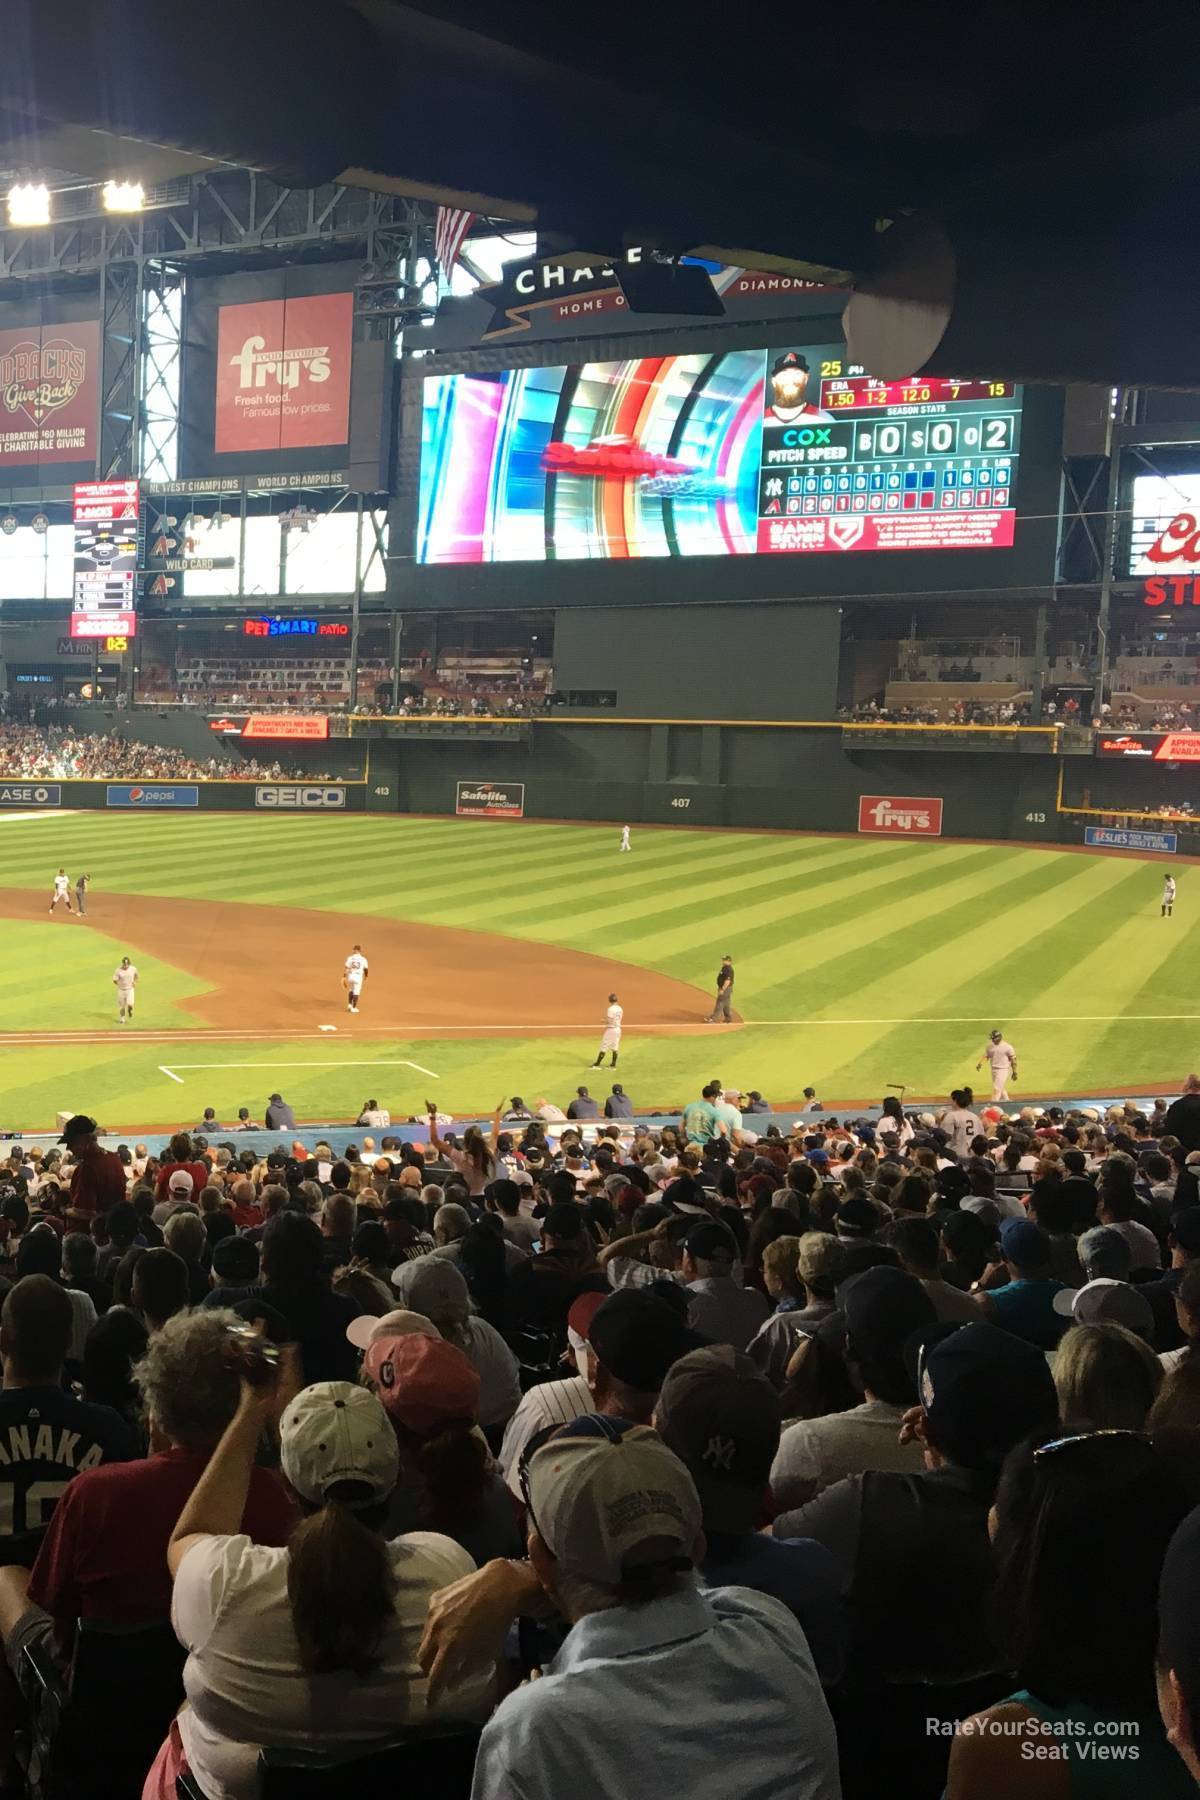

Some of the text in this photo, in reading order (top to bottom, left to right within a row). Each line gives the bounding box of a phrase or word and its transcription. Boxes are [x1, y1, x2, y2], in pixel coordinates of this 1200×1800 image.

[560, 299, 602, 316] HOME
[230, 336, 331, 389] fry's
[821, 361, 842, 376] 25
[831, 381, 849, 391] ERA
[6, 380, 75, 410] Give Back
[235, 393, 291, 406] Fresh food.
[827, 383, 1005, 407] 1.50 1-2 12.0 7 15
[243, 405, 299, 418] Famous low
[887, 405, 947, 416] SEASON STATS
[57, 428, 85, 437] MILLION
[783, 428, 832, 446] COX
[859, 433, 872, 451] B
[880, 426, 901, 453] 0
[911, 430, 924, 448] S
[931, 423, 952, 451] 0
[986, 420, 1006, 448] 2
[4, 440, 53, 452] CHARITABLE
[56, 438, 85, 448] GIVING
[768, 446, 848, 463] PITCH SPEED
[150, 479, 239, 493] NL WEST CHAMPIONS
[258, 473, 342, 487] WORLD CHAMPIONS
[789, 491, 1006, 511] 0 2 0 1 0 0 0 3 5 1 4
[166, 558, 214, 570] WILD CARD
[244, 619, 348, 636] PETSMART PATIO
[145, 790, 175, 802] pepsi
[257, 788, 344, 806] GEICO
[374, 787, 390, 796] 413
[461, 791, 507, 801] Safelite
[671, 798, 691, 808] 407
[870, 801, 930, 830] fry's
[1025, 812, 1046, 823] 413
[965, 1120, 975, 1136] 2
